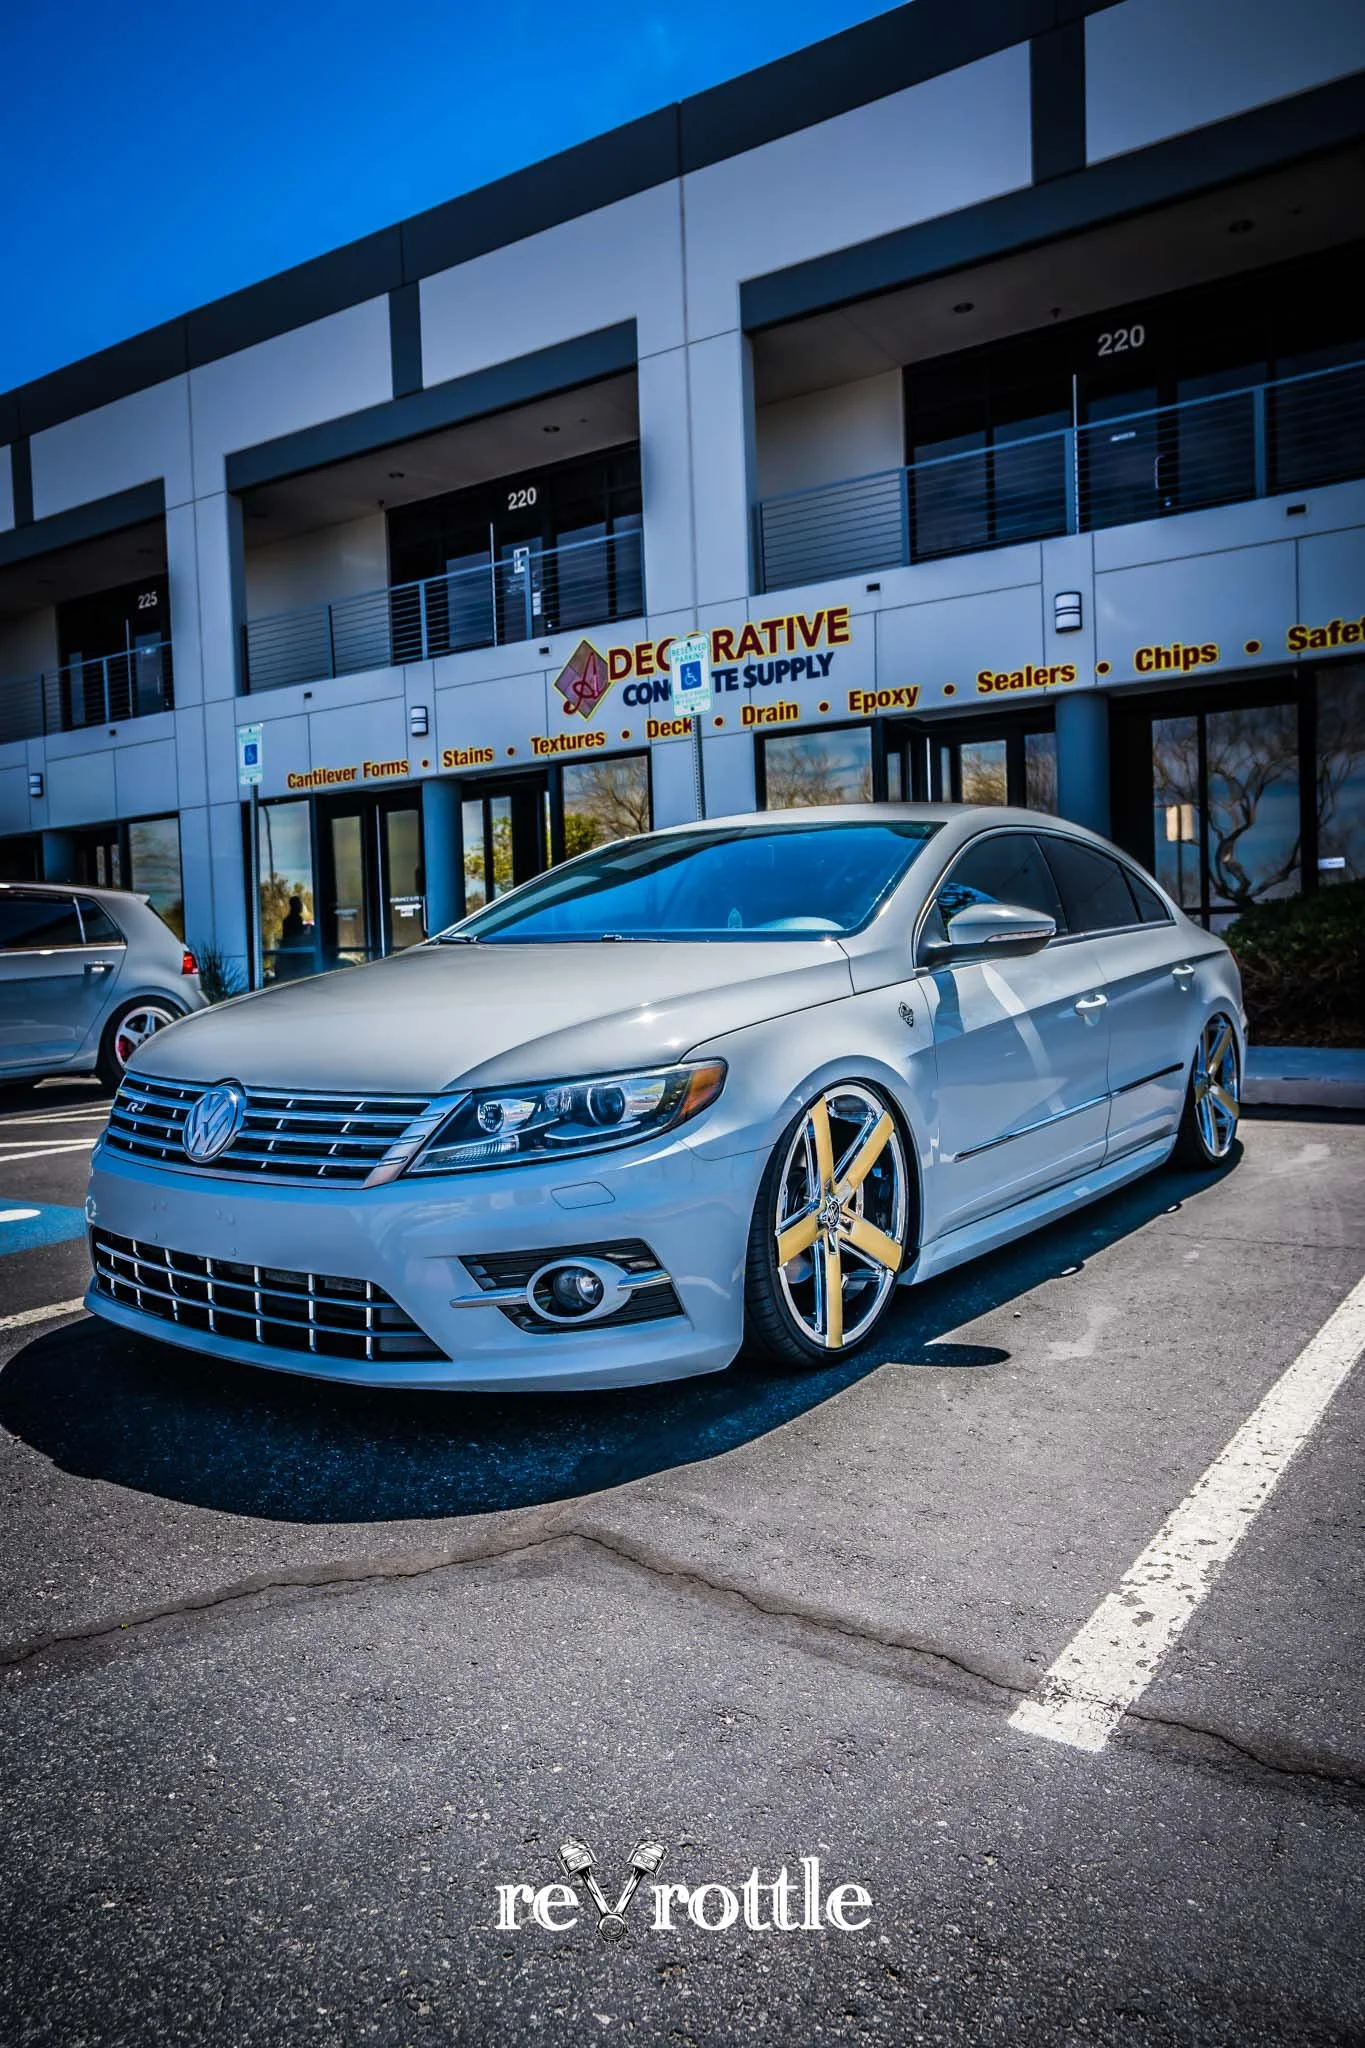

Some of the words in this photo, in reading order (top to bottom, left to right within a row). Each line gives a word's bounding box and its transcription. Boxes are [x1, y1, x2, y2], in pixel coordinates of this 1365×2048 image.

[1097, 324, 1146, 357] 220
[507, 486, 538, 511] 220
[137, 591, 159, 610] 225
[608, 607, 850, 681] DECRATIVE
[1134, 641, 1219, 673] Chips
[622, 668, 740, 706] CONTE
[743, 651, 835, 689] SUPPLY
[976, 662, 1077, 693] Sealers
[741, 702, 799, 726] Drain
[848, 685, 920, 713] Epoxy
[442, 746, 494, 768] Stains
[531, 730, 605, 755] Textures
[286, 765, 358, 790] Cantilever
[362, 758, 410, 779] Forms
[182, 1085, 241, 1163] VW
